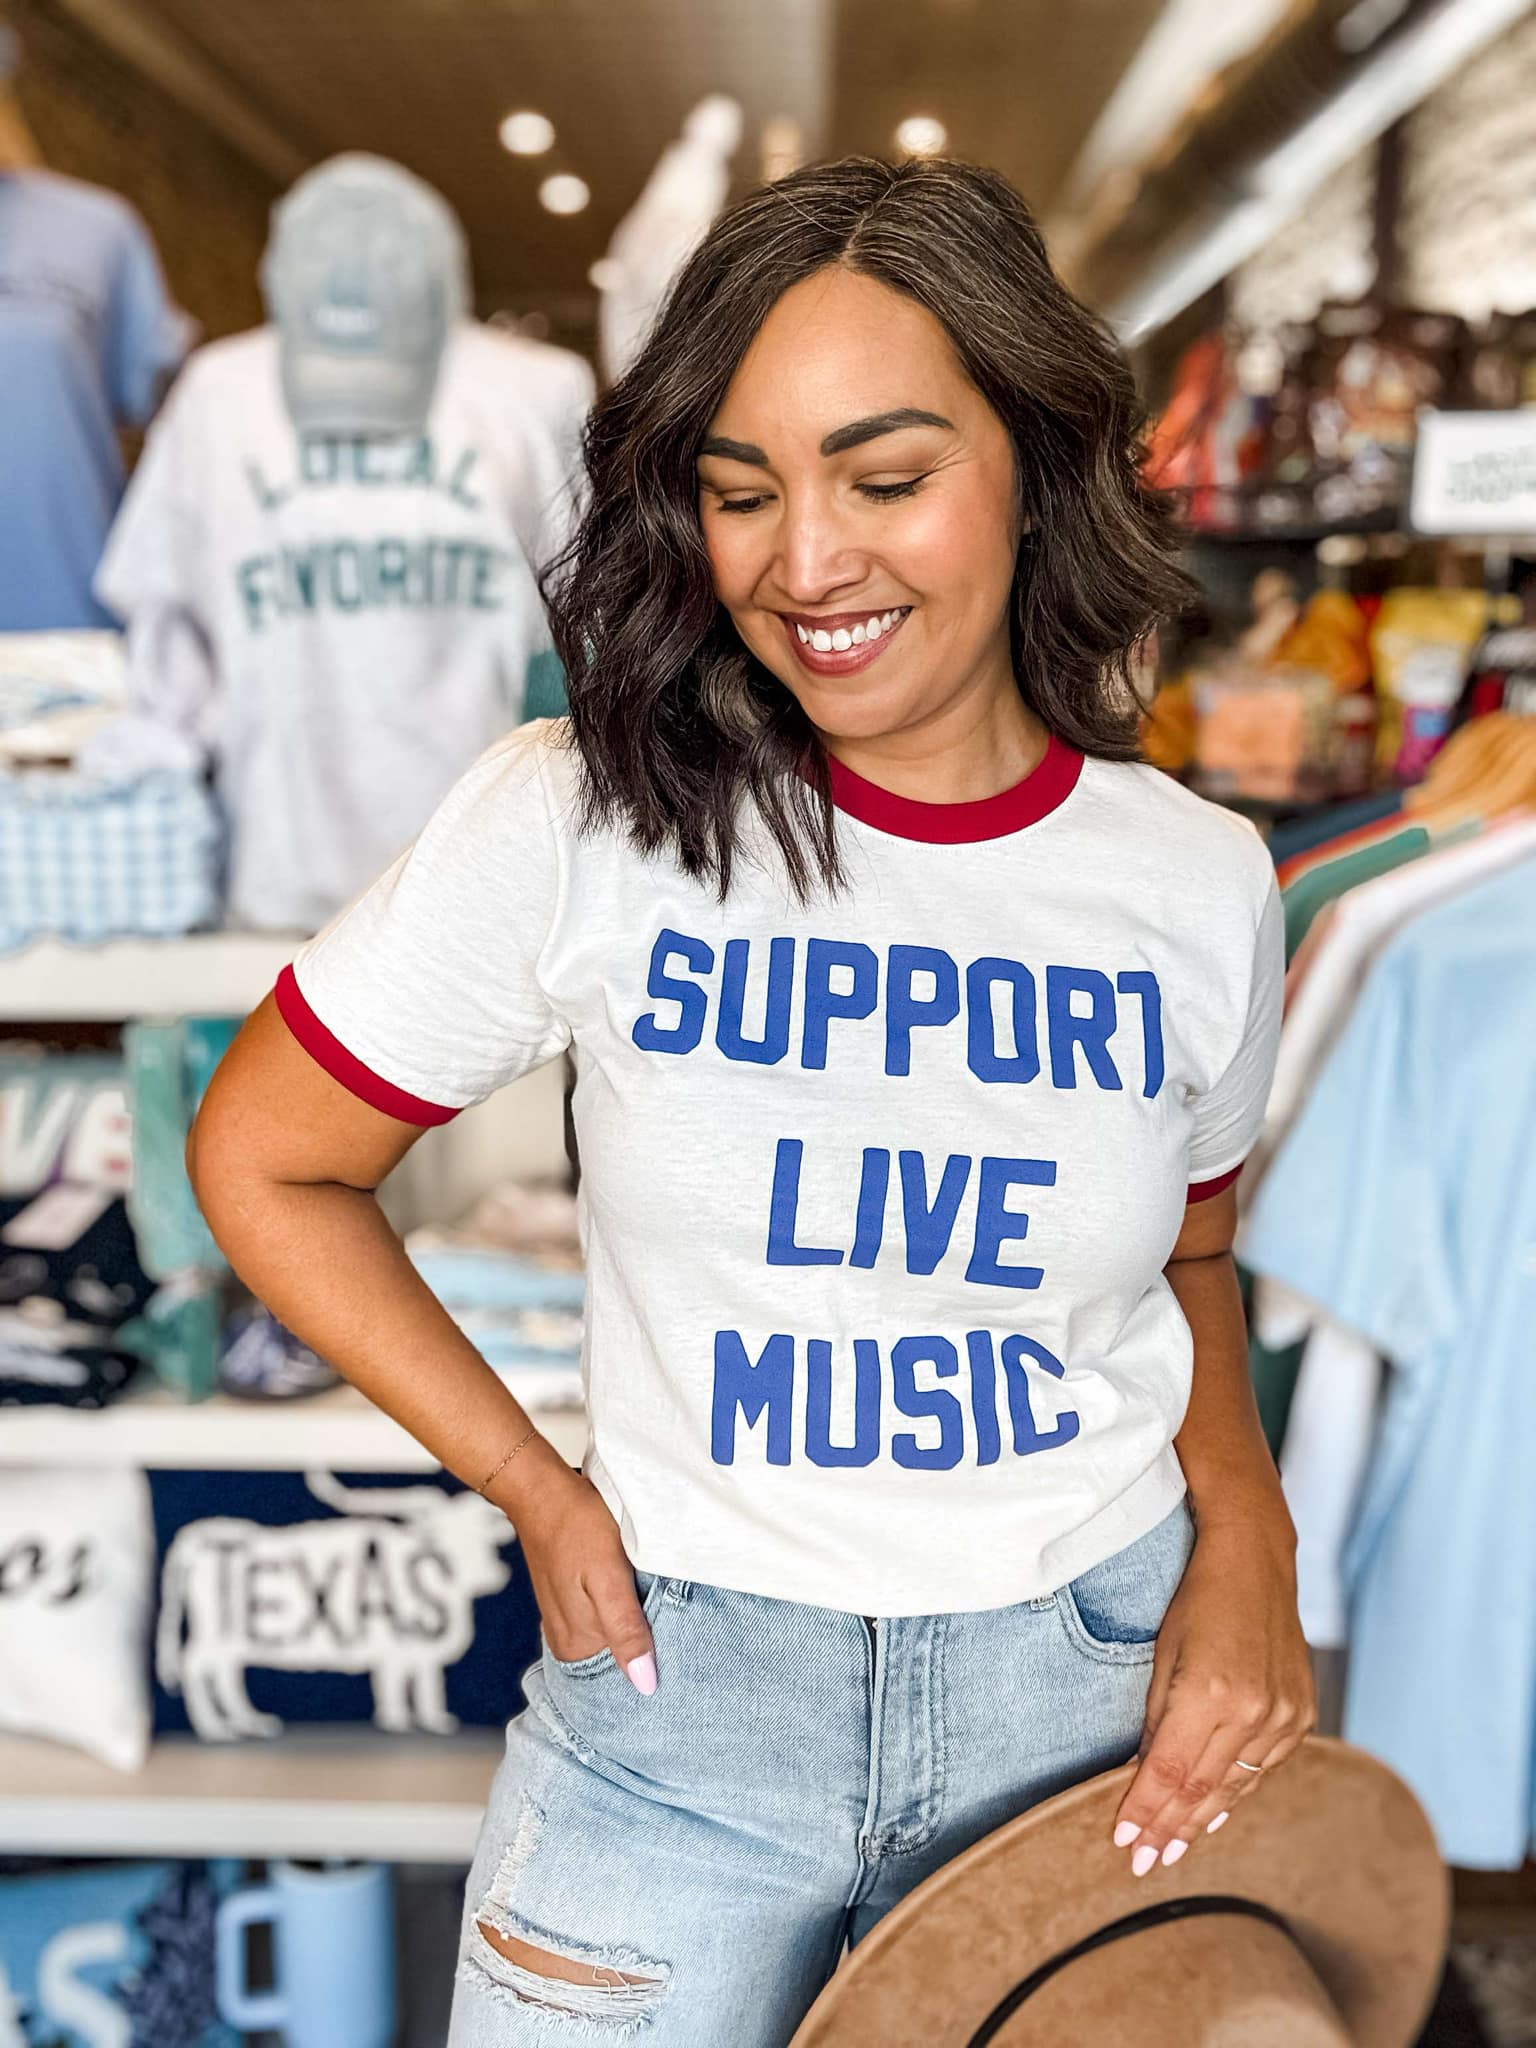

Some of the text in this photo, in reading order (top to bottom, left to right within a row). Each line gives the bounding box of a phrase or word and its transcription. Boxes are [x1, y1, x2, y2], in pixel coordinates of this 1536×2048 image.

[241, 432, 481, 512] LOCAL
[631, 928, 1165, 1099] SUPPORT
[766, 1138, 1057, 1290] LIVE
[711, 1330, 1080, 1471] MUSIC
[204, 1536, 456, 1646] TEXAS
